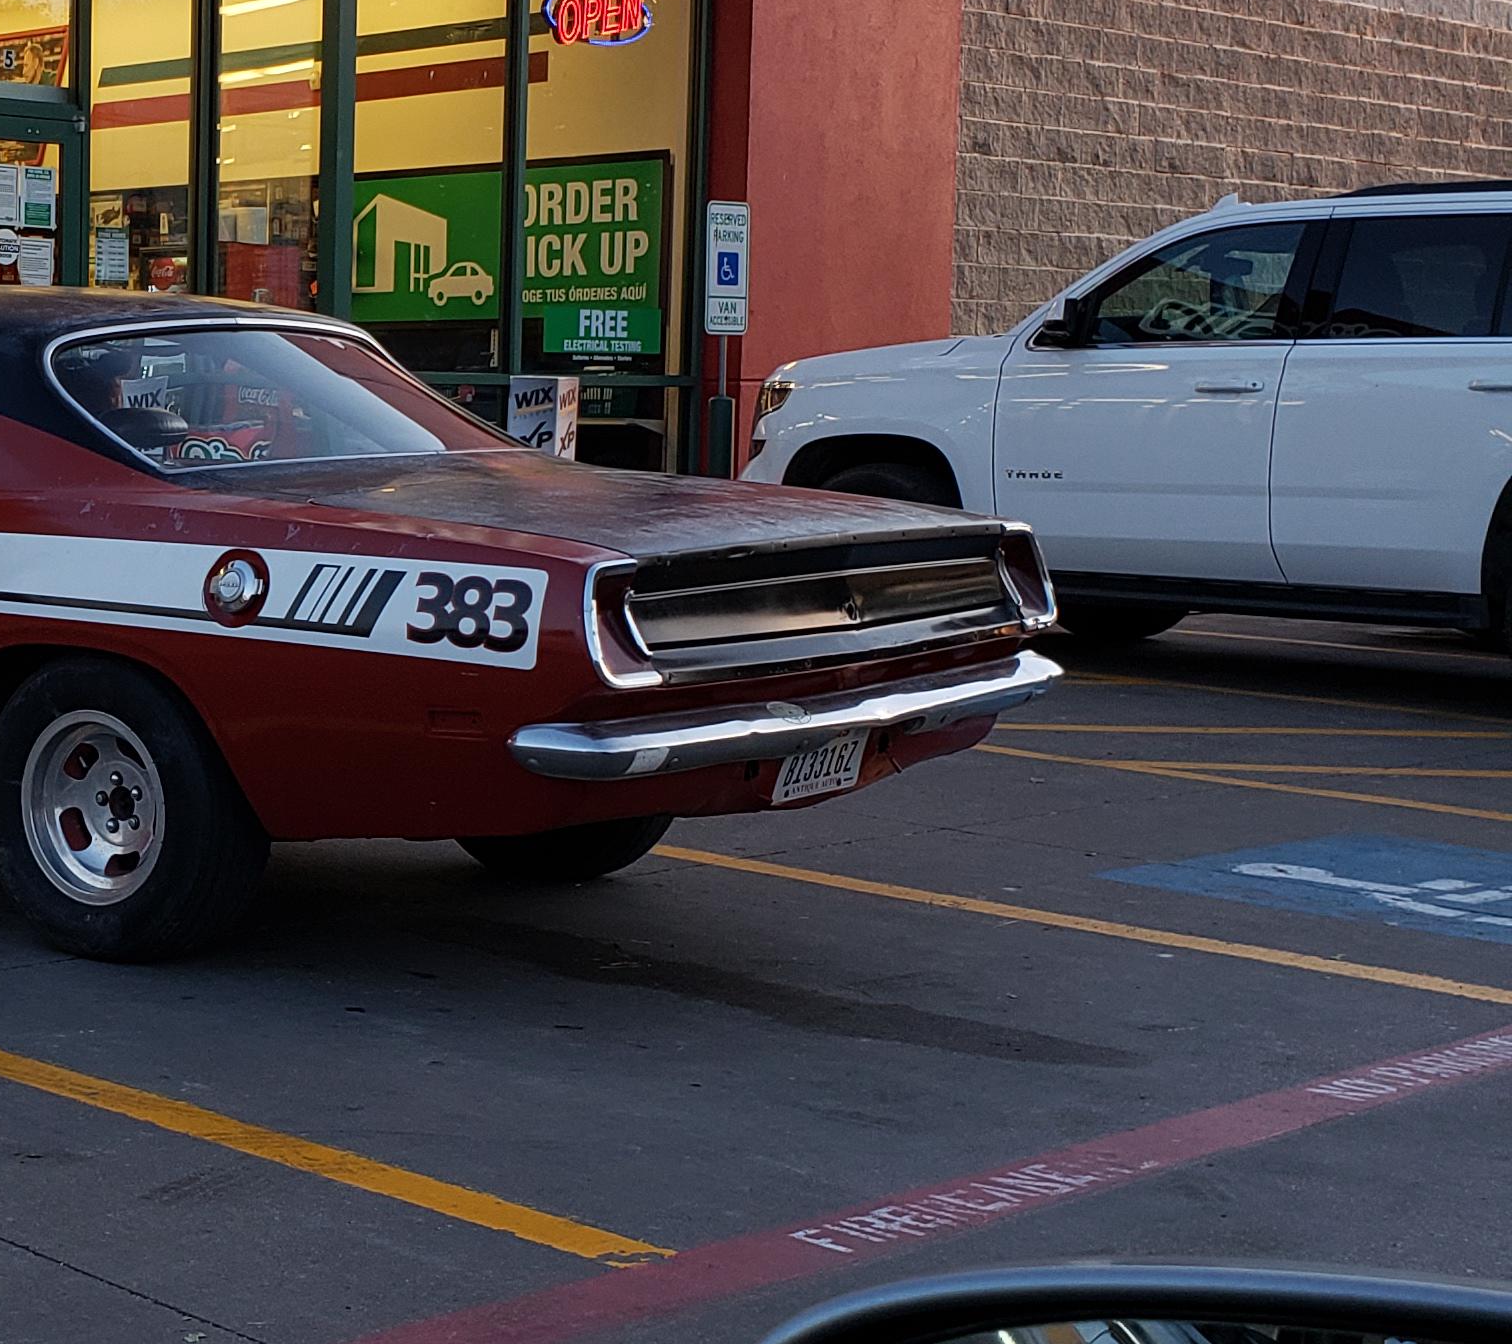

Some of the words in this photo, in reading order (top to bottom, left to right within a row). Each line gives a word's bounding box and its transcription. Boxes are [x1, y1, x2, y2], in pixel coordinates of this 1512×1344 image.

[710, 212, 746, 227] RESERVED
[714, 229, 744, 243] PARKING
[526, 233, 587, 278] ICK
[600, 230, 649, 275] UP
[546, 288, 566, 301] TUS
[569, 286, 617, 301] ÓRDENES
[718, 301, 737, 314] VAN
[579, 309, 628, 338] FREE
[564, 339, 609, 352] ELECTRICAL
[611, 340, 642, 353] TESTING
[128, 388, 163, 408] WIX
[514, 386, 554, 410] WIX
[559, 386, 577, 411] WIX
[1005, 469, 1064, 479] TAHOE
[406, 571, 533, 653] 383
